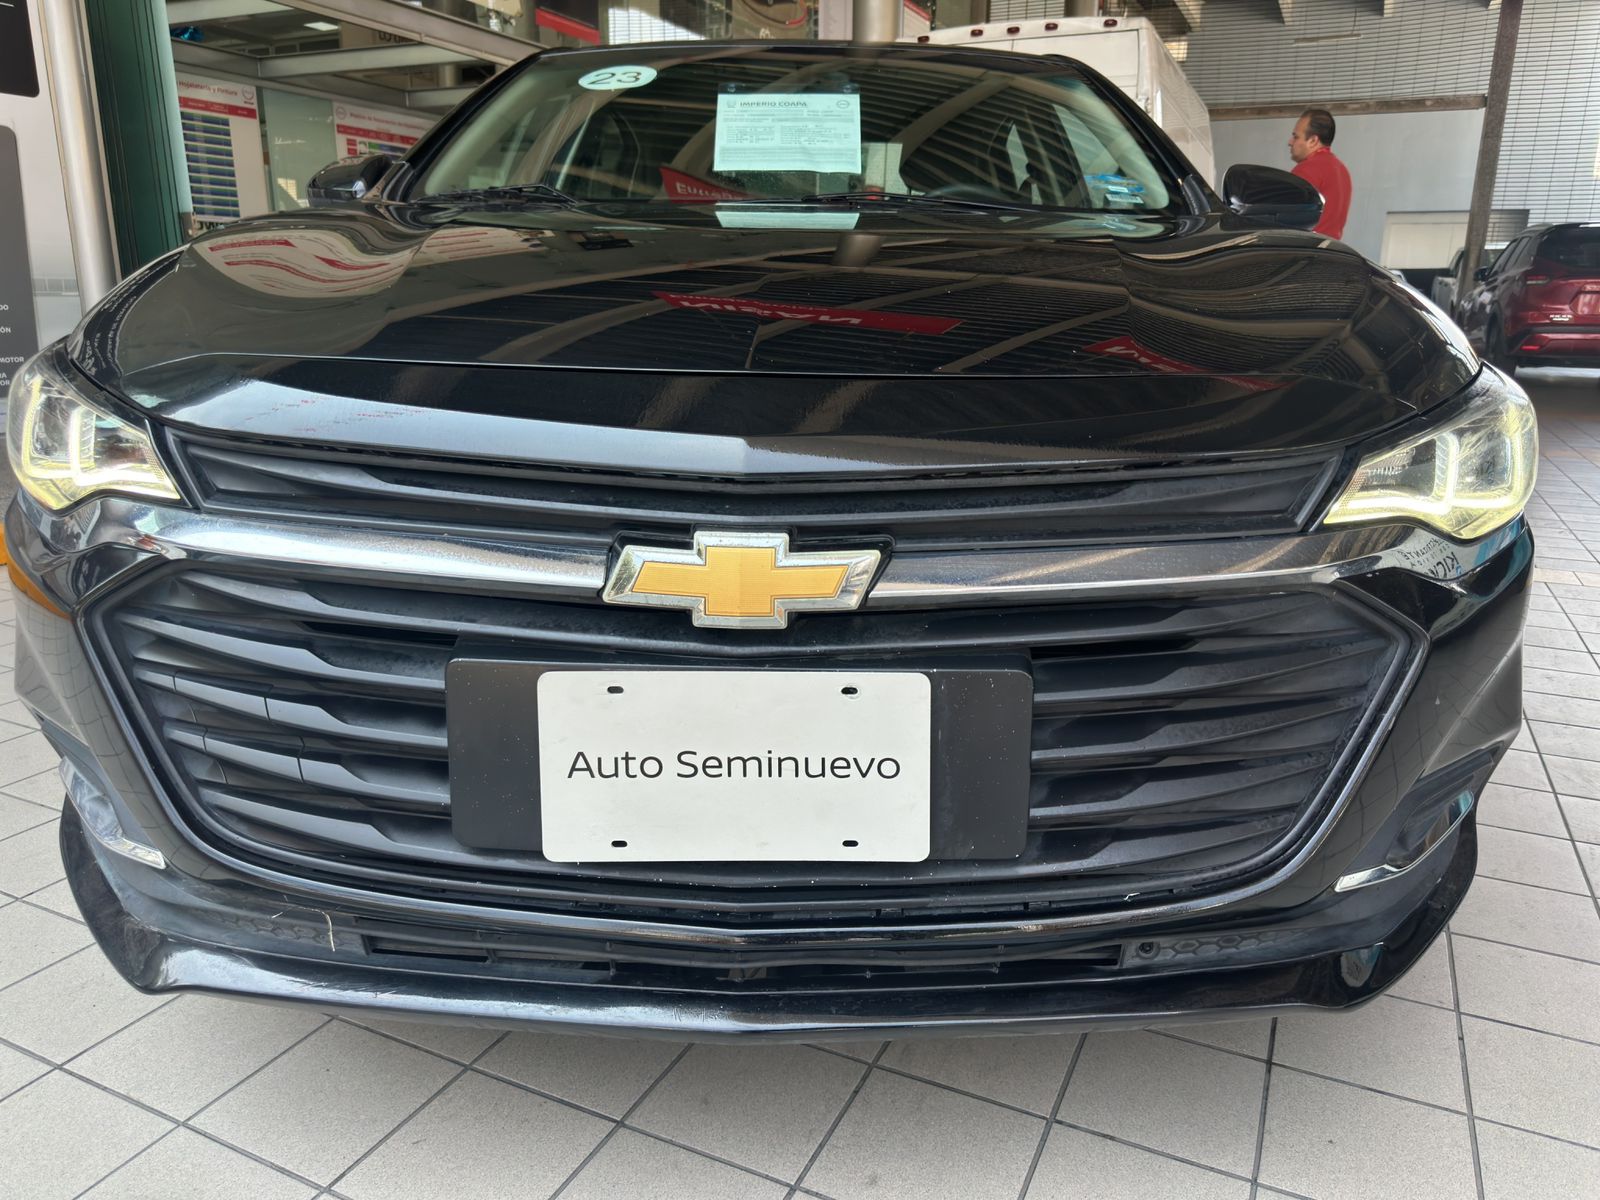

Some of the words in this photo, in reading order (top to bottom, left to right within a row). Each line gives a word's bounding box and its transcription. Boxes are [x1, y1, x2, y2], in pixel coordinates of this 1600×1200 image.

[587, 71, 641, 85] 23
[567, 750, 664, 779] Auto
[676, 750, 901, 780] Seminuevo
